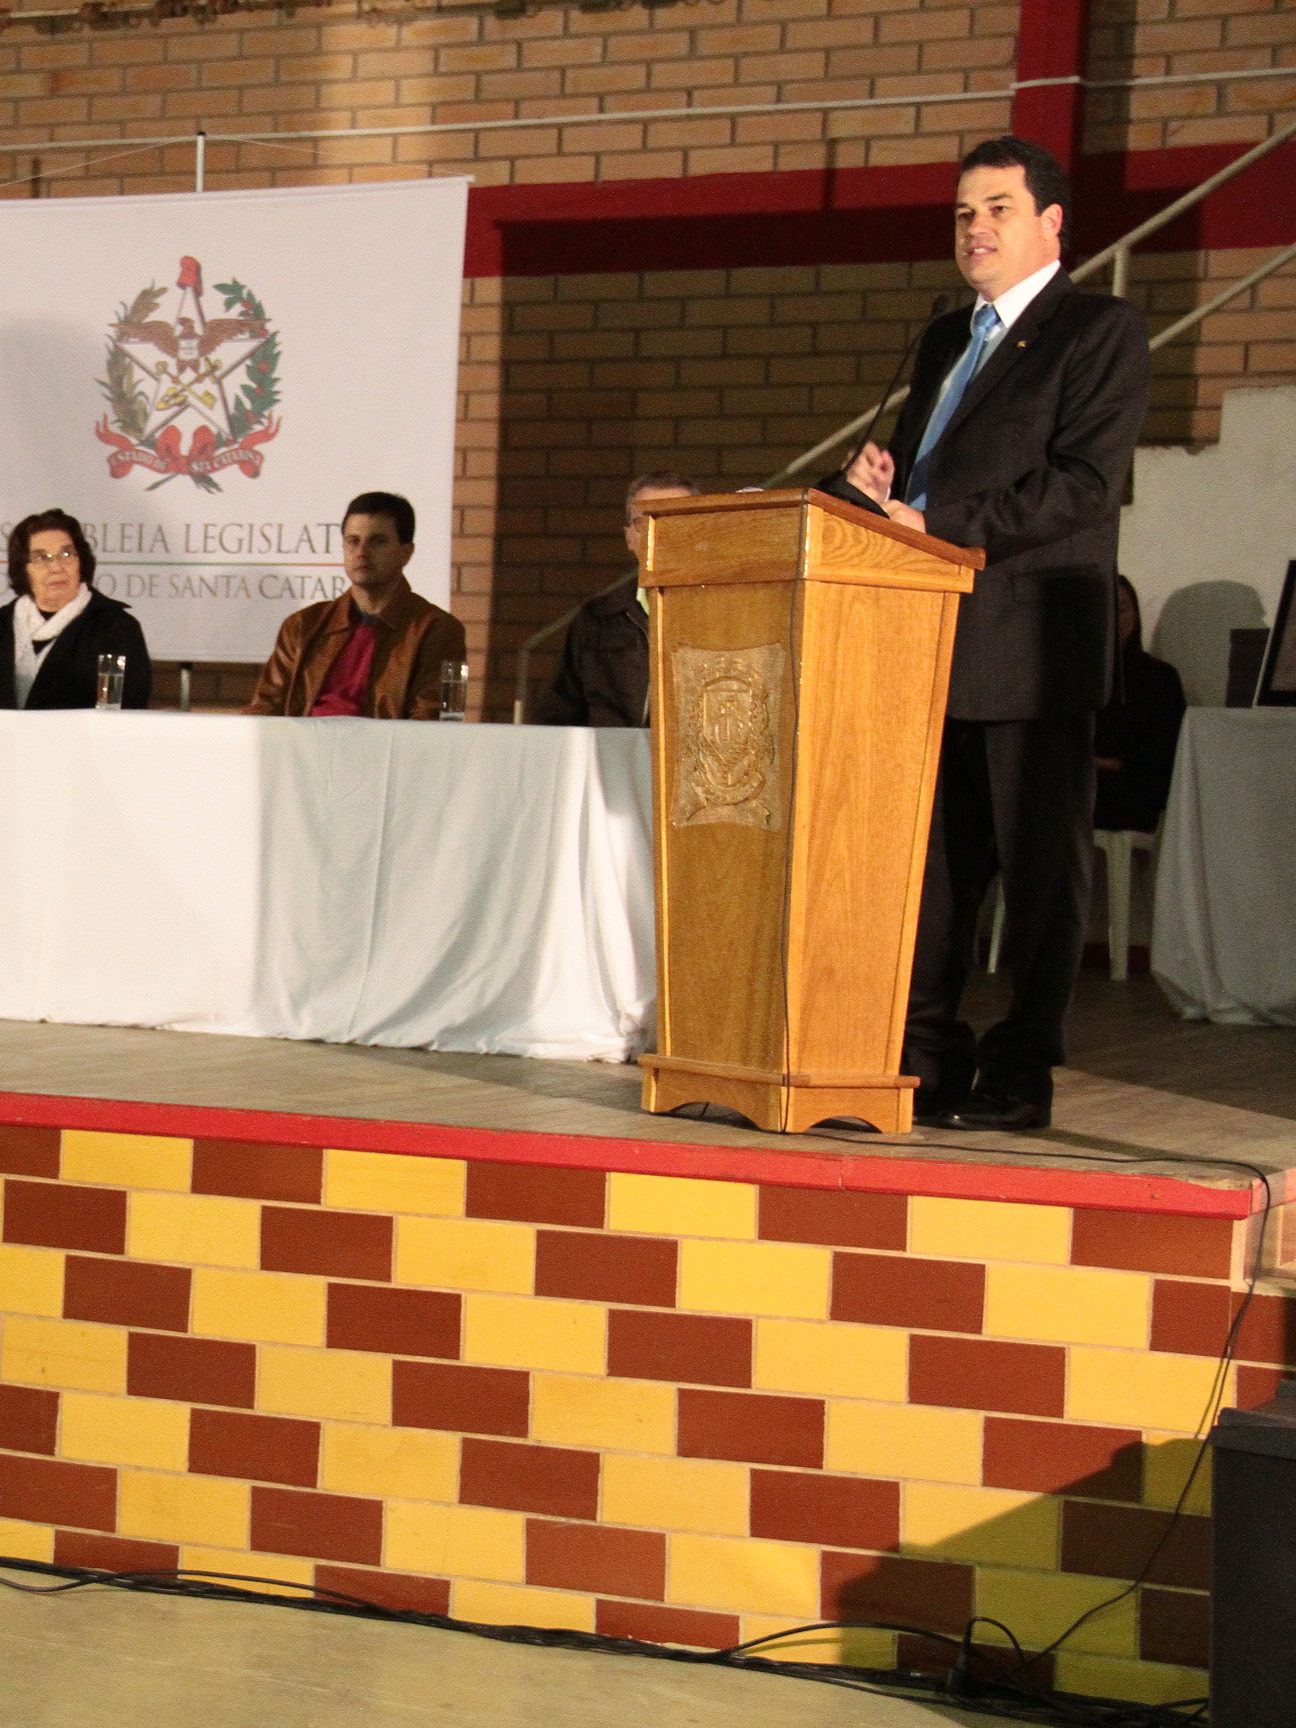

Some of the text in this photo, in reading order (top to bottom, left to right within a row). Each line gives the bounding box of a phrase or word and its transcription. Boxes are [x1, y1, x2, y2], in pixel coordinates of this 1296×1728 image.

[184, 522, 341, 554] LEGISLAT
[126, 573, 160, 599] DE
[168, 573, 252, 600] SANTA
[259, 574, 345, 600] CATAR
